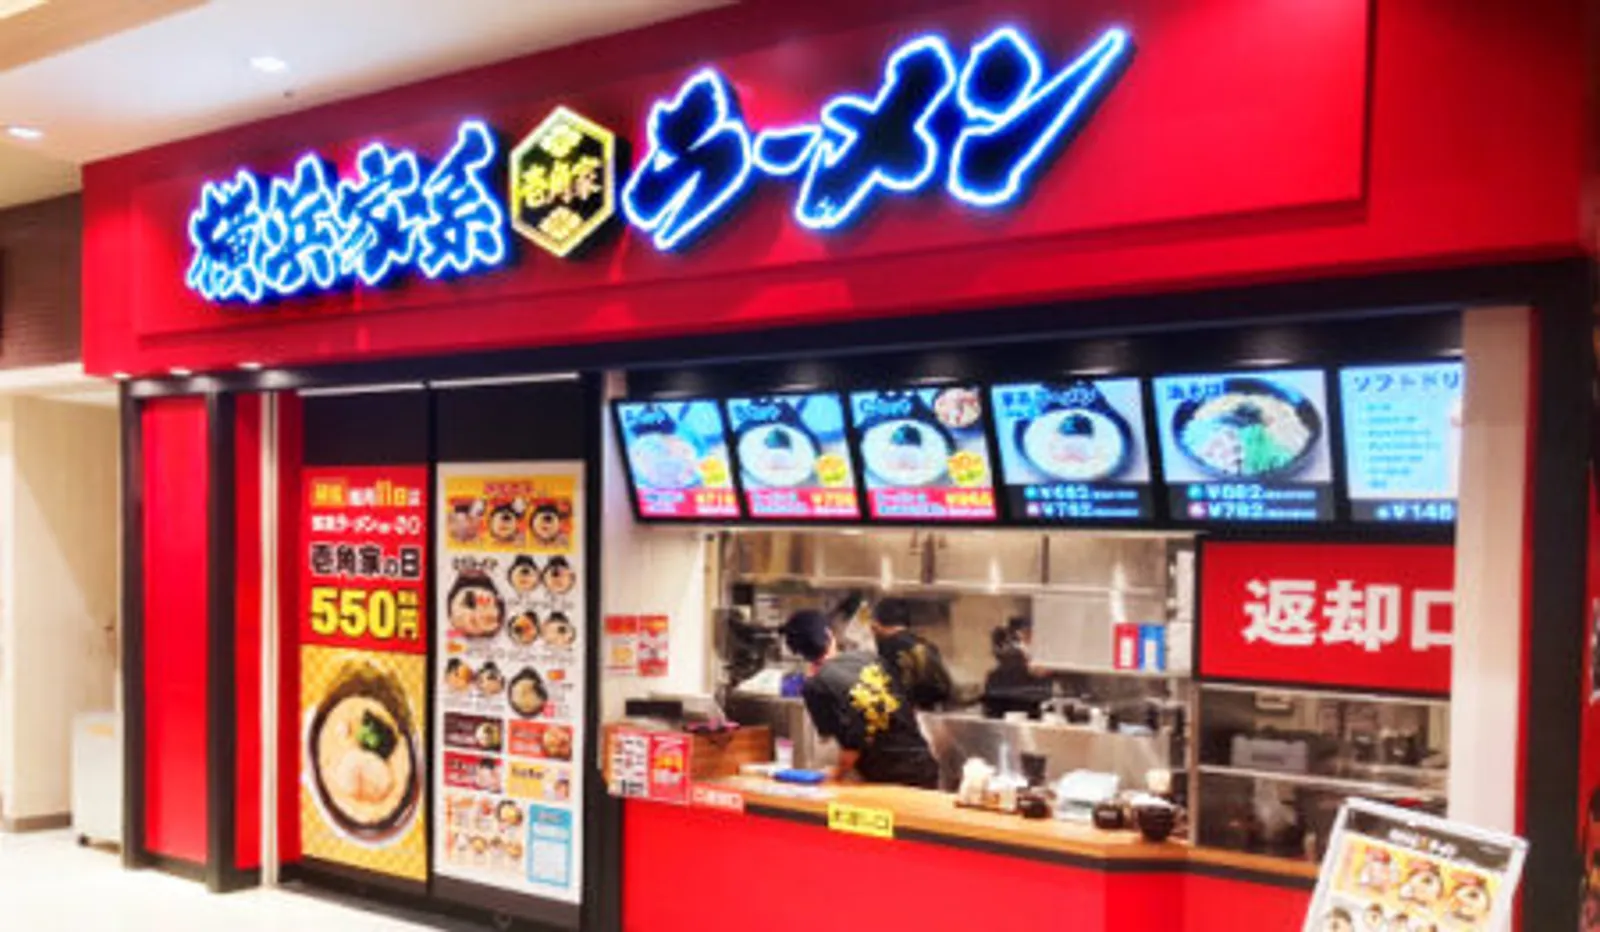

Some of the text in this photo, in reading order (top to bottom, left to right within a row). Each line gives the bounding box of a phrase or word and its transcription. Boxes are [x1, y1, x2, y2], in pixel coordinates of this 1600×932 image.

[186, 117, 507, 303] 横浜家系
[622, 25, 1128, 250] ラーメン
[311, 543, 421, 580] 壱角家の日
[1241, 578, 1454, 652] 返却口
